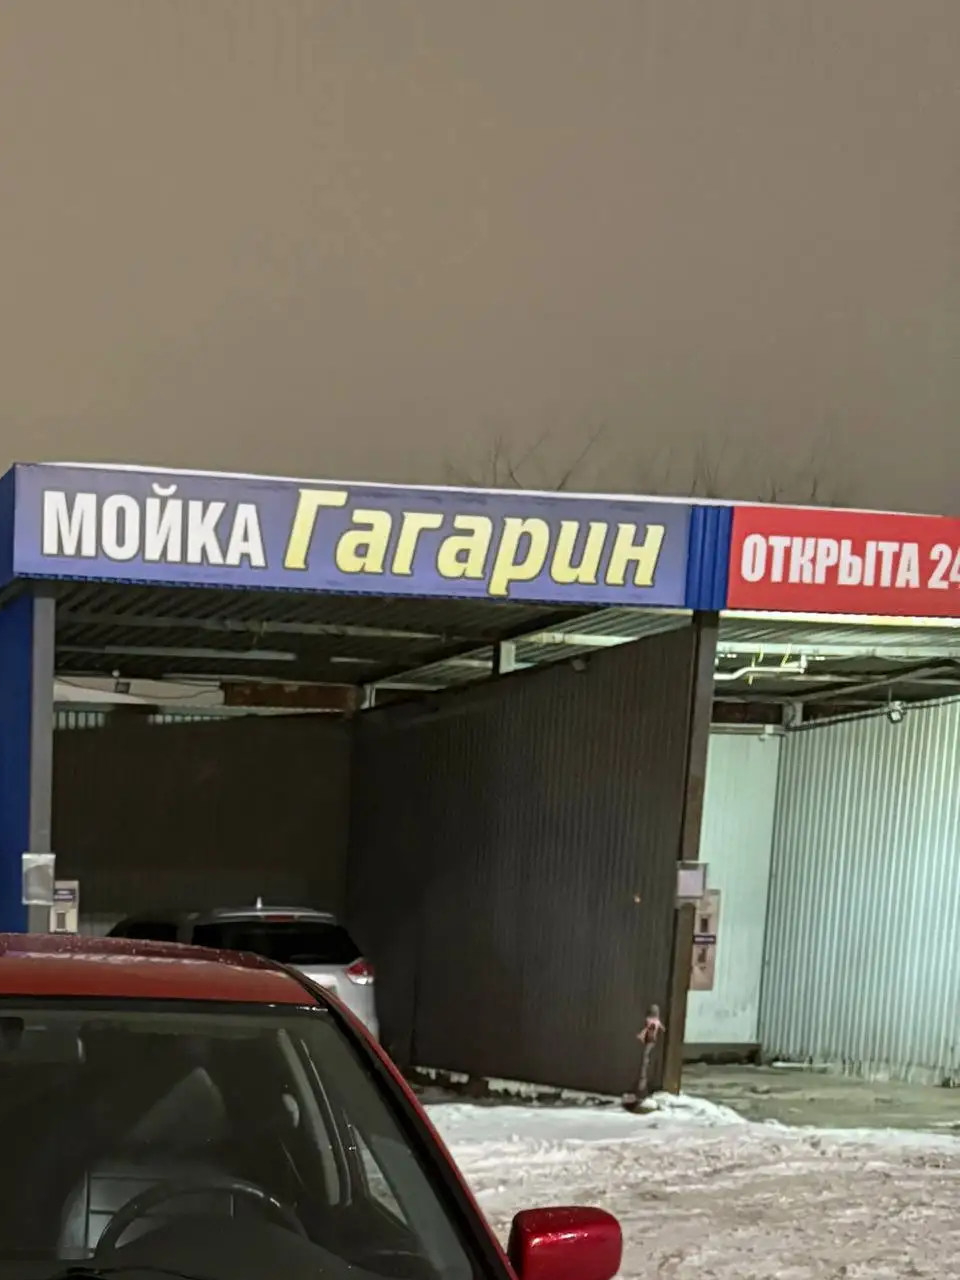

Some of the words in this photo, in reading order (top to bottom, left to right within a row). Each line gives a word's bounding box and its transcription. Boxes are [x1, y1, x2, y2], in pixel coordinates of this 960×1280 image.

[43, 482, 267, 568] МОЙКА
[283, 488, 666, 597] Гагарин
[741, 533, 920, 589] ОТКРЫТА
